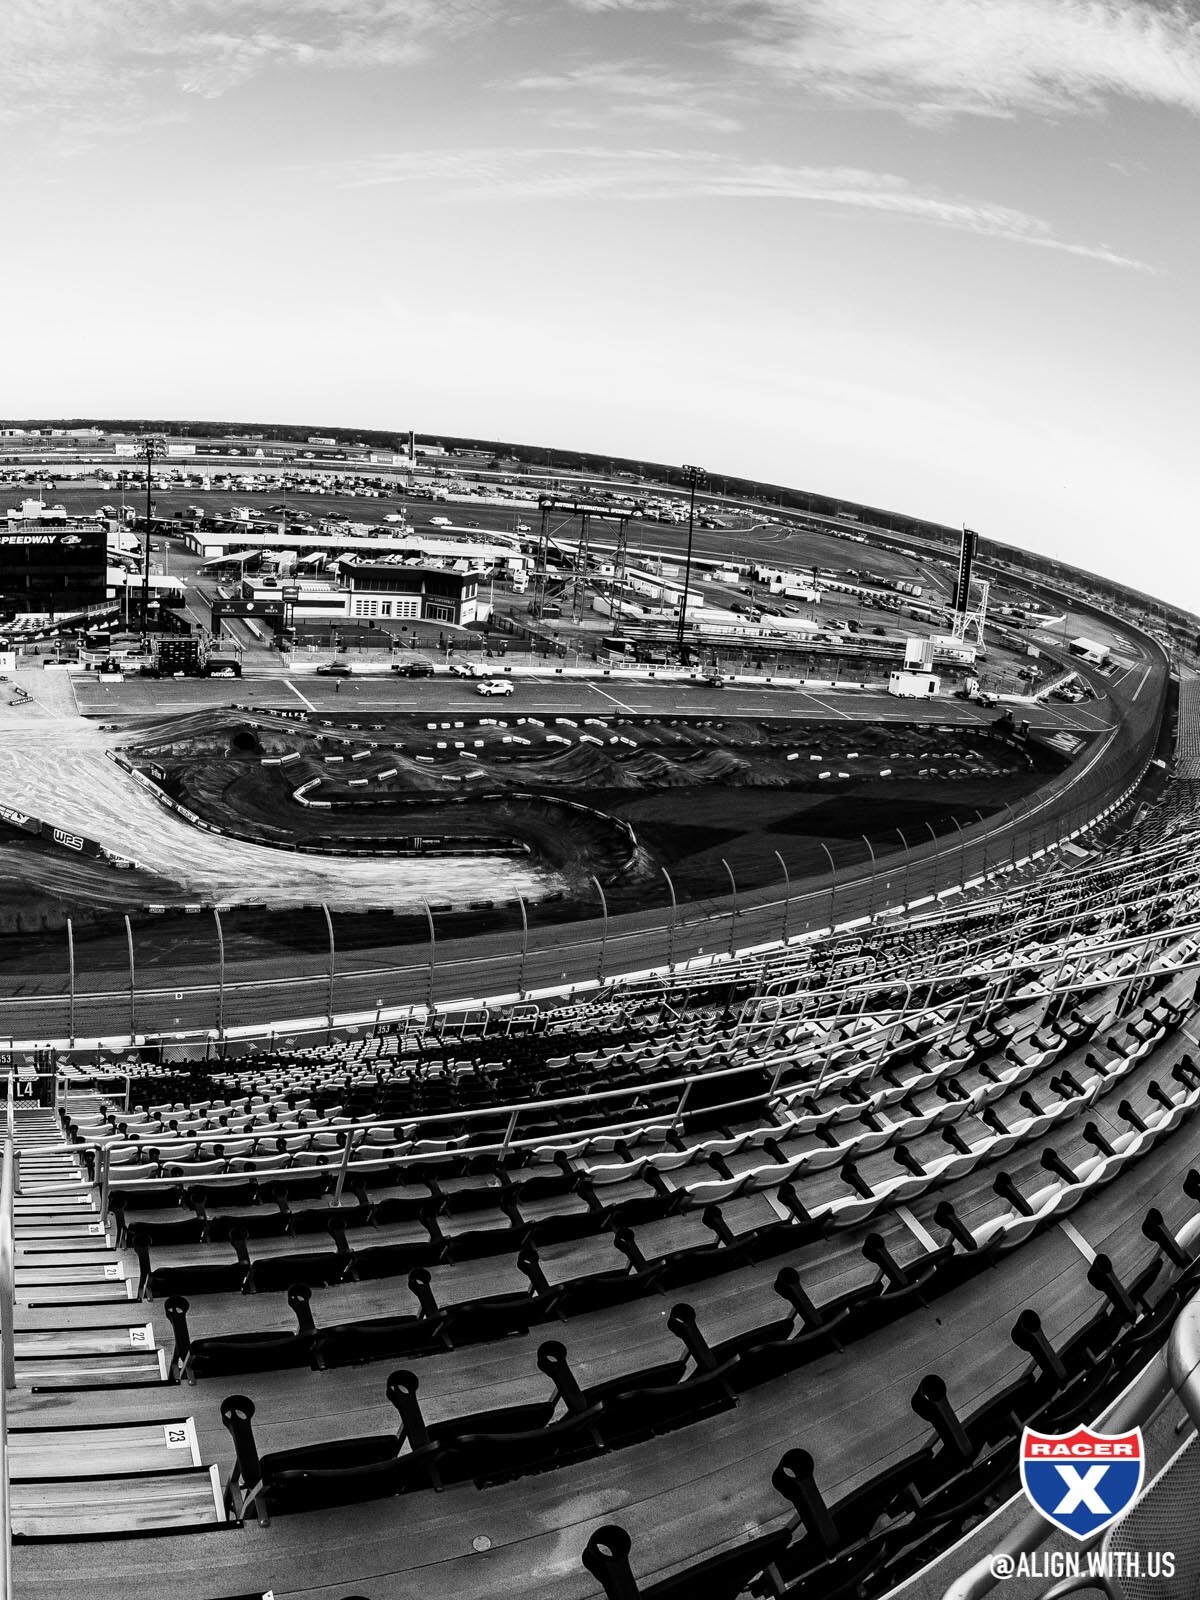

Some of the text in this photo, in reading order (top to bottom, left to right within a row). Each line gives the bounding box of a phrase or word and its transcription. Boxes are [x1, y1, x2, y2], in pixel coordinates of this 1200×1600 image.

[53, 828, 84, 851] WPS
[16, 1081, 34, 1097] L4
[132, 1332, 145, 1341] 22
[168, 1430, 186, 1443] 23
